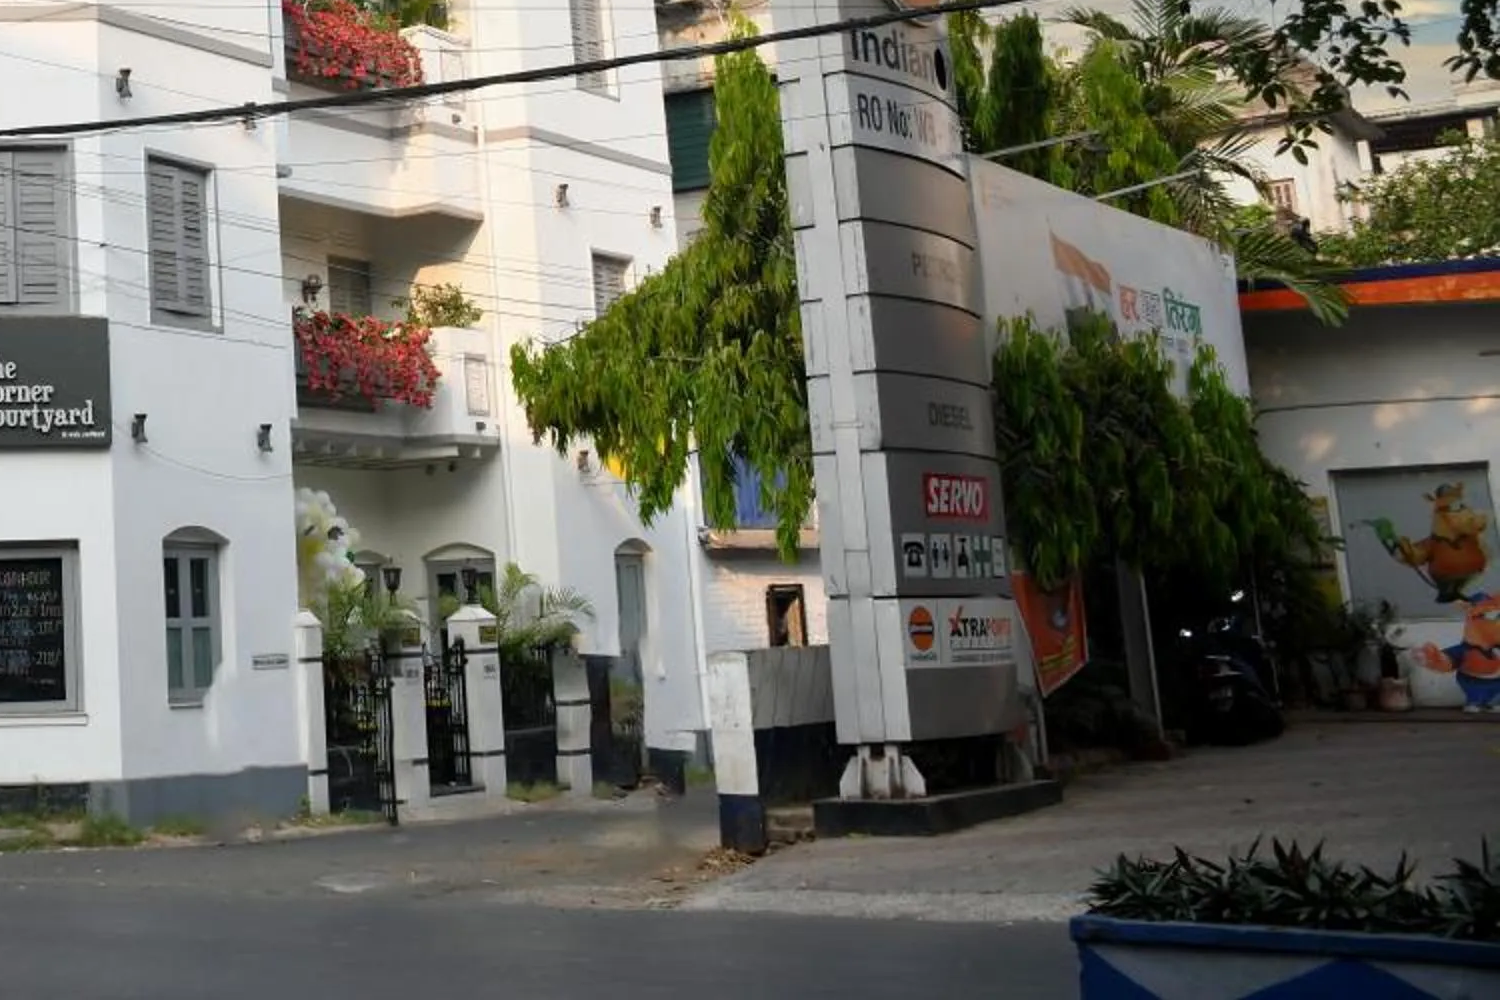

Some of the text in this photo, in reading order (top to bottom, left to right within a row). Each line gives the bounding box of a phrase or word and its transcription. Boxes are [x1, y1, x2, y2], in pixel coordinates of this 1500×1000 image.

[857, 93, 883, 132] RO
[927, 402, 975, 431] DIESEL
[927, 477, 984, 516] SERVO
